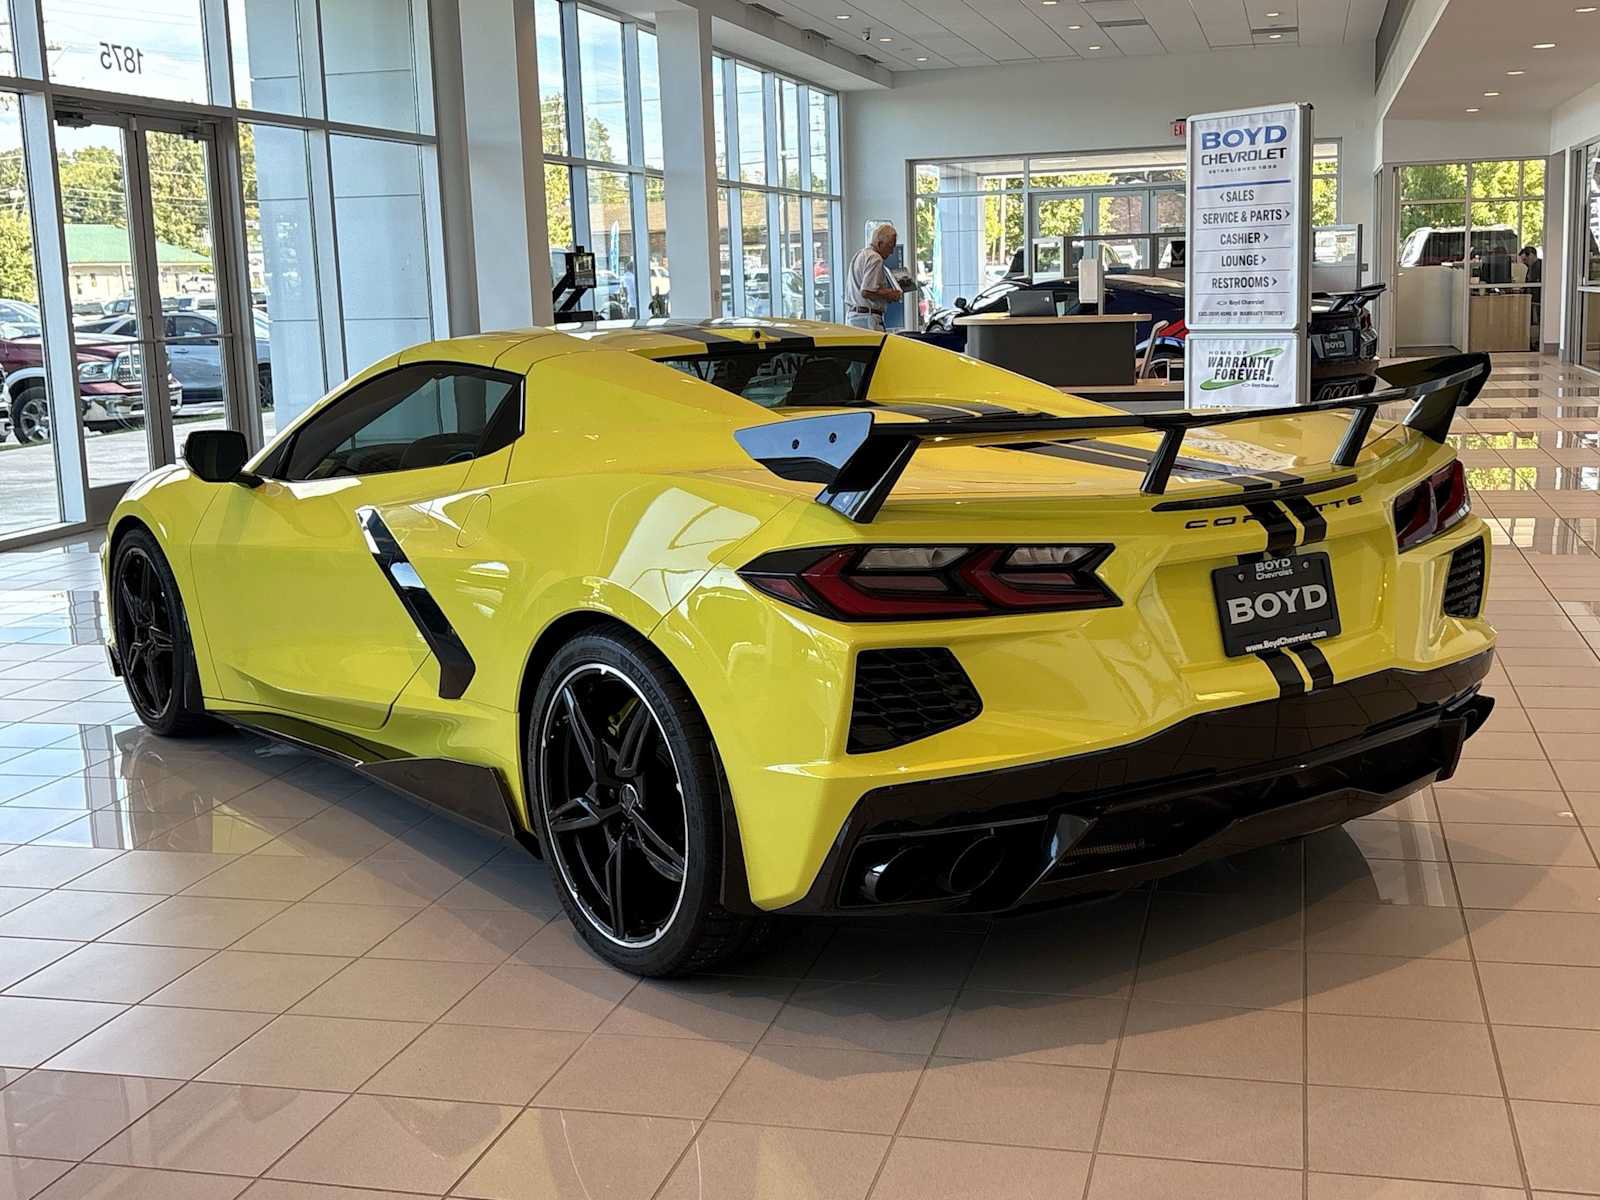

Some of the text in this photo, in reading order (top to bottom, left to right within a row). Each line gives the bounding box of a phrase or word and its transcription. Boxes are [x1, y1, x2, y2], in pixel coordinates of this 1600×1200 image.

[1201, 125, 1288, 150] BOYD
[1201, 147, 1288, 166] CHEVROLET
[1226, 190, 1254, 202] SALES
[1202, 208, 1282, 224] SERVICE & PARTS
[1220, 232, 1261, 245] CASHIER
[1221, 254, 1259, 267] LOUNGE
[1212, 276, 1270, 289] RESTROOMS
[1207, 356, 1270, 369] WARRANTY
[1185, 494, 1363, 530] CORTTE
[1255, 558, 1291, 571] BOYD
[1255, 569, 1294, 580] Chevrolet
[1226, 584, 1328, 625] BOYD
[1245, 630, 1328, 653] www.BoydChevrolet.com
